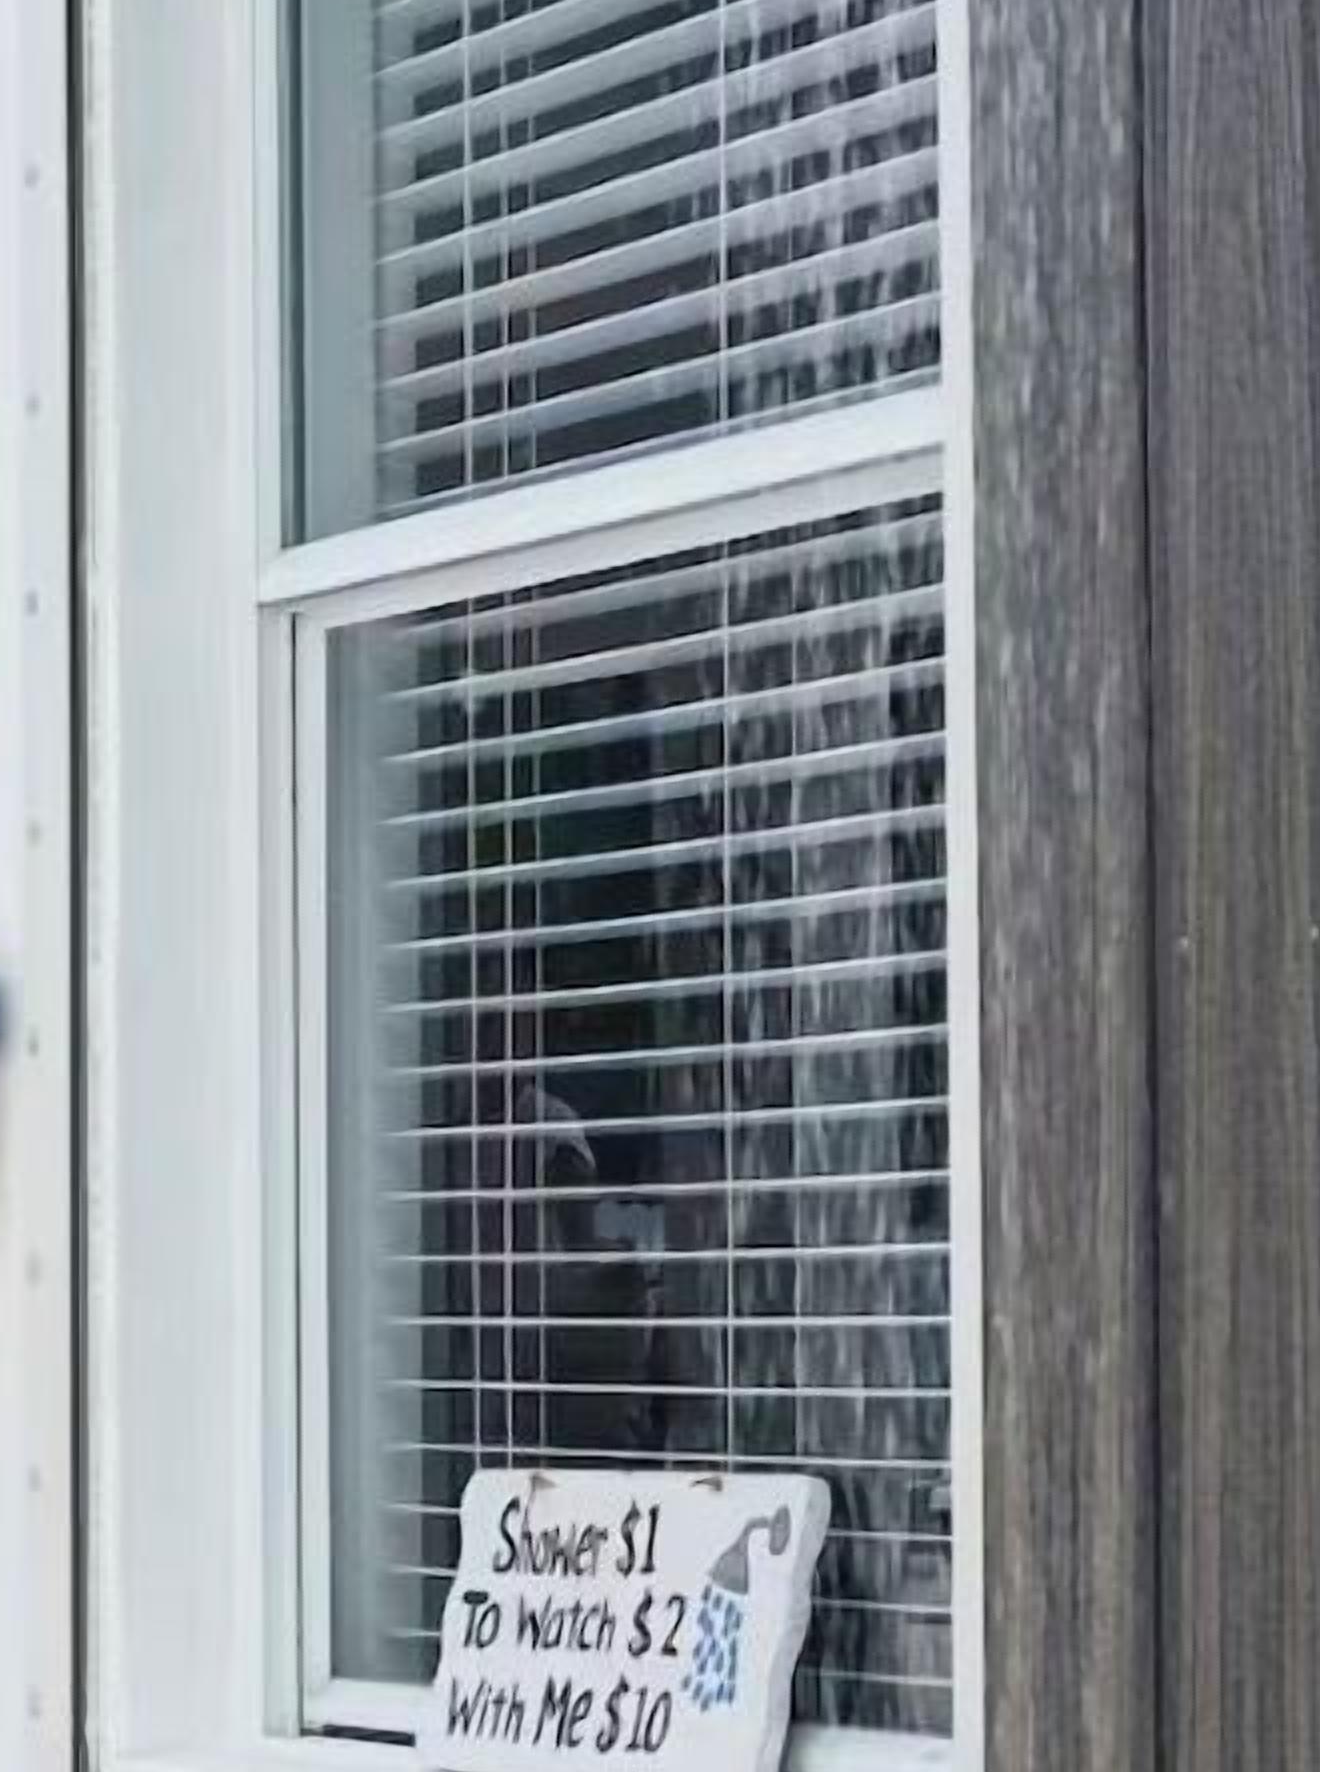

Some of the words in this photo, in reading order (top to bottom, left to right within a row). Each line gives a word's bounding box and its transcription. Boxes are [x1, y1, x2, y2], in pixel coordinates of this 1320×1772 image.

[492, 1490, 608, 1578] Shower
[615, 1499, 660, 1578] $1
[463, 1589, 501, 1648] To
[518, 1594, 616, 1652] Watch
[447, 1675, 525, 1743] With
[533, 1675, 594, 1749] Me
[596, 1674, 673, 1754] $10
